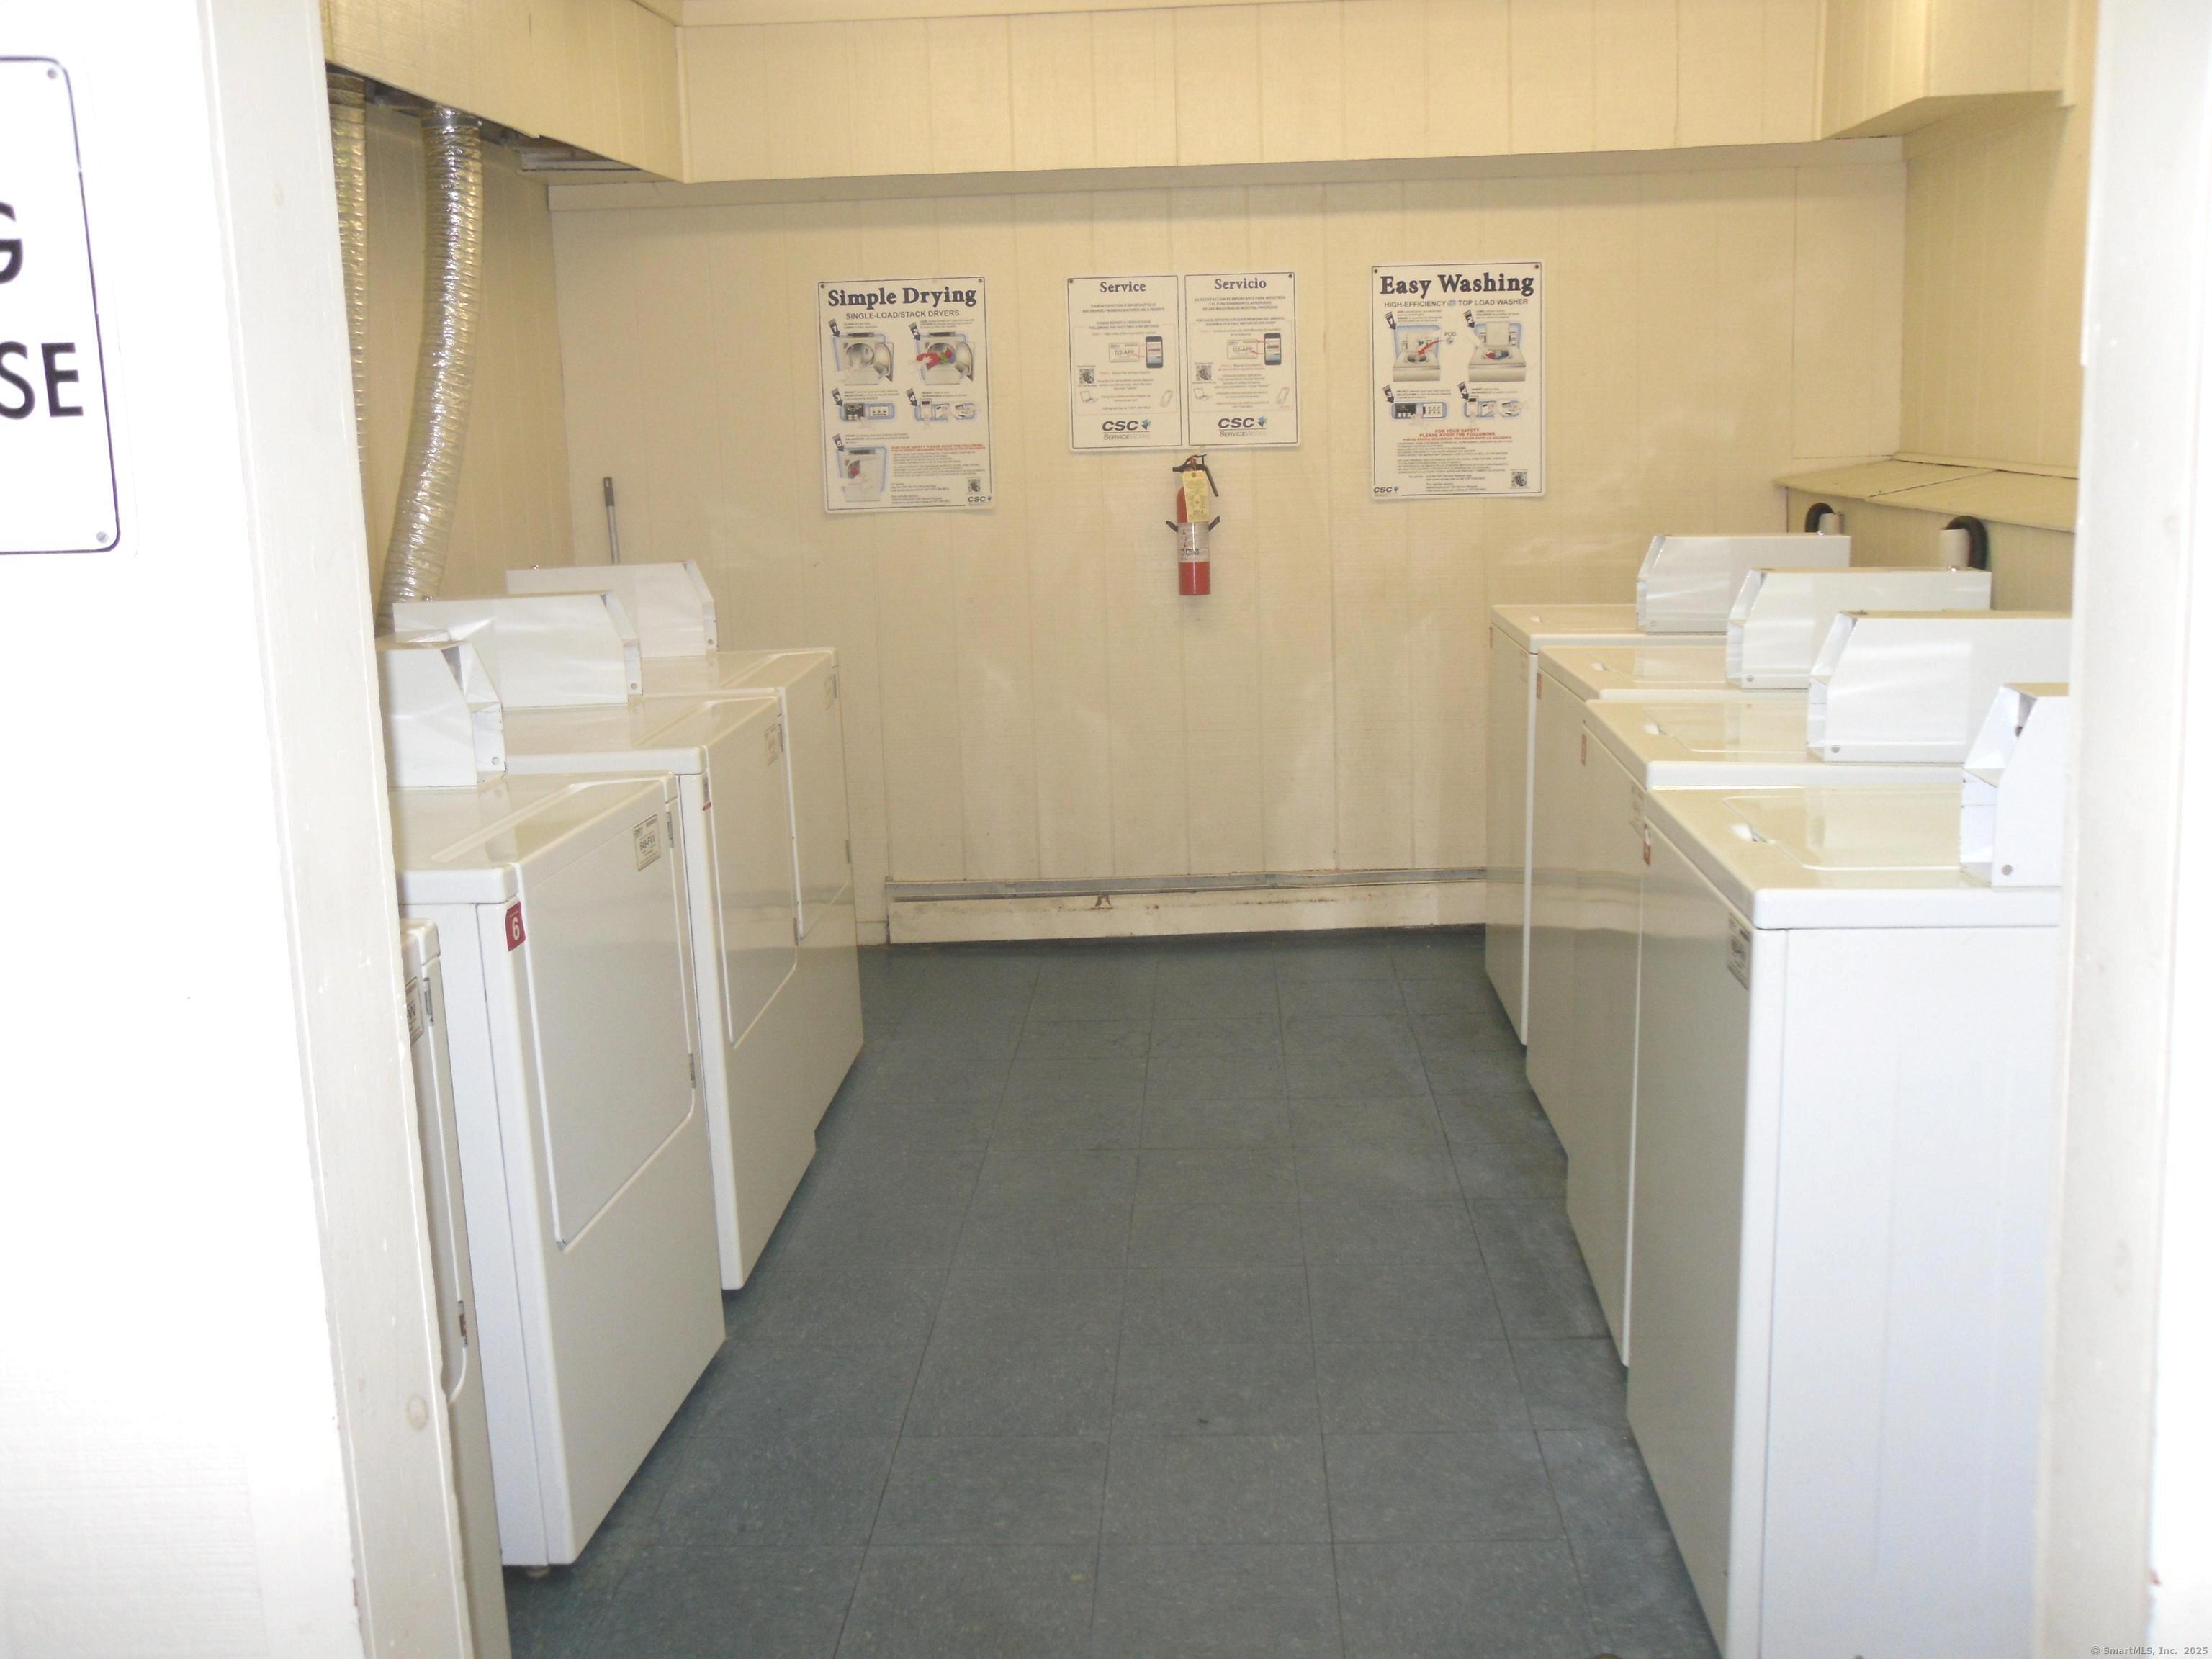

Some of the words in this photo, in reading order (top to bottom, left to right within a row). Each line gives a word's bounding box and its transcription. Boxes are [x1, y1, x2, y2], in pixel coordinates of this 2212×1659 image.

[1100, 282, 1146, 292] Service
[1215, 278, 1267, 289] Servicio
[1380, 276, 1432, 299] Easy
[1437, 272, 1534, 296] Washing
[828, 287, 896, 310] Simple
[903, 287, 976, 307] Drying
[845, 310, 926, 320] SINGLE-LOAD/STACK
[1102, 421, 1139, 431] CSC
[1218, 418, 1254, 428] CSC
[512, 917, 520, 940] 6
